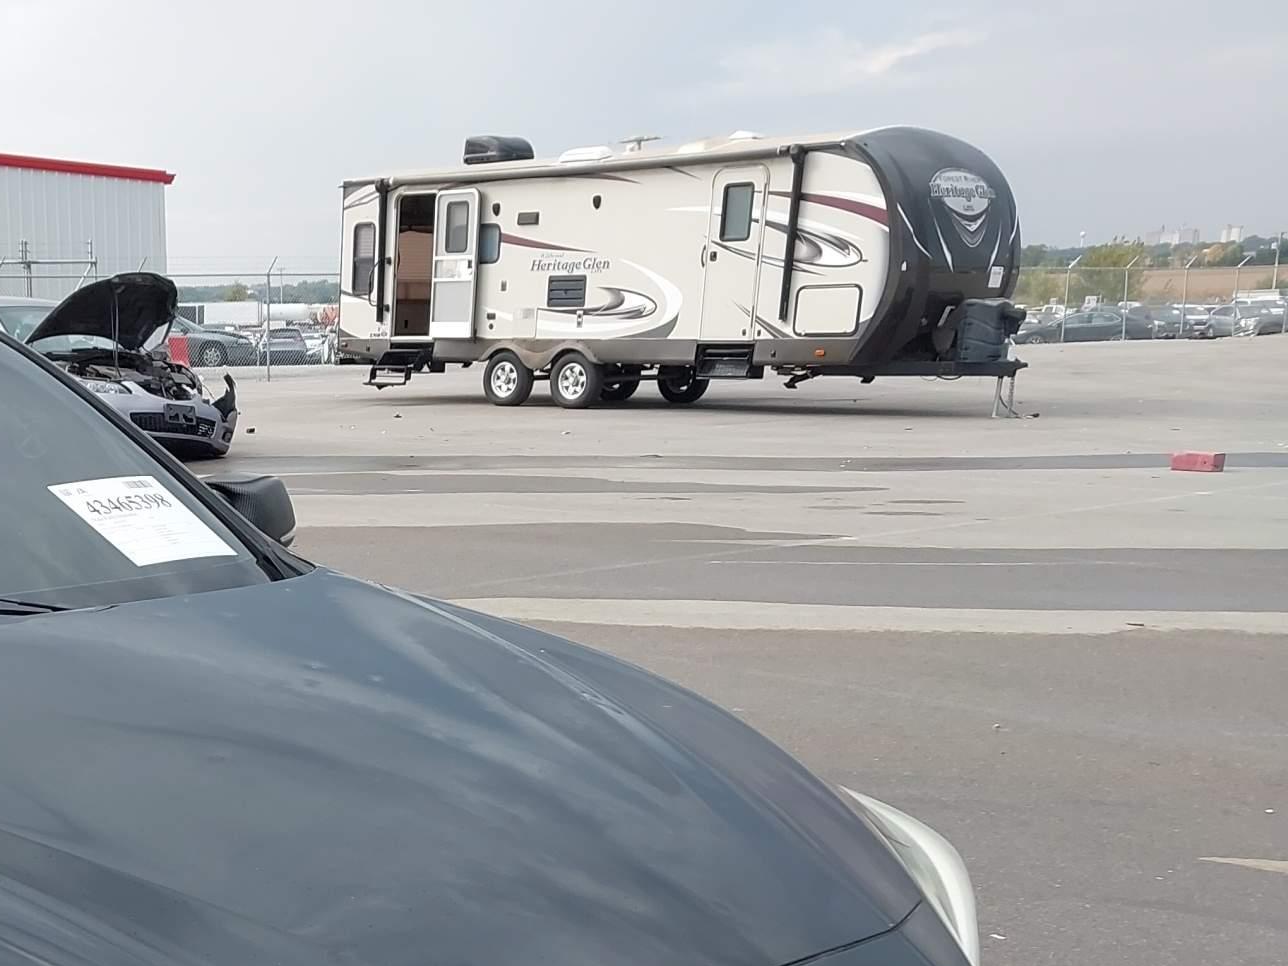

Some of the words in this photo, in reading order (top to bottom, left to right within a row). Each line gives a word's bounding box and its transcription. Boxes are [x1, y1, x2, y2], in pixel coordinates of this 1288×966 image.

[530, 258, 582, 274] Heritage
[582, 256, 610, 270] Glen
[86, 493, 172, 515] 43465398
